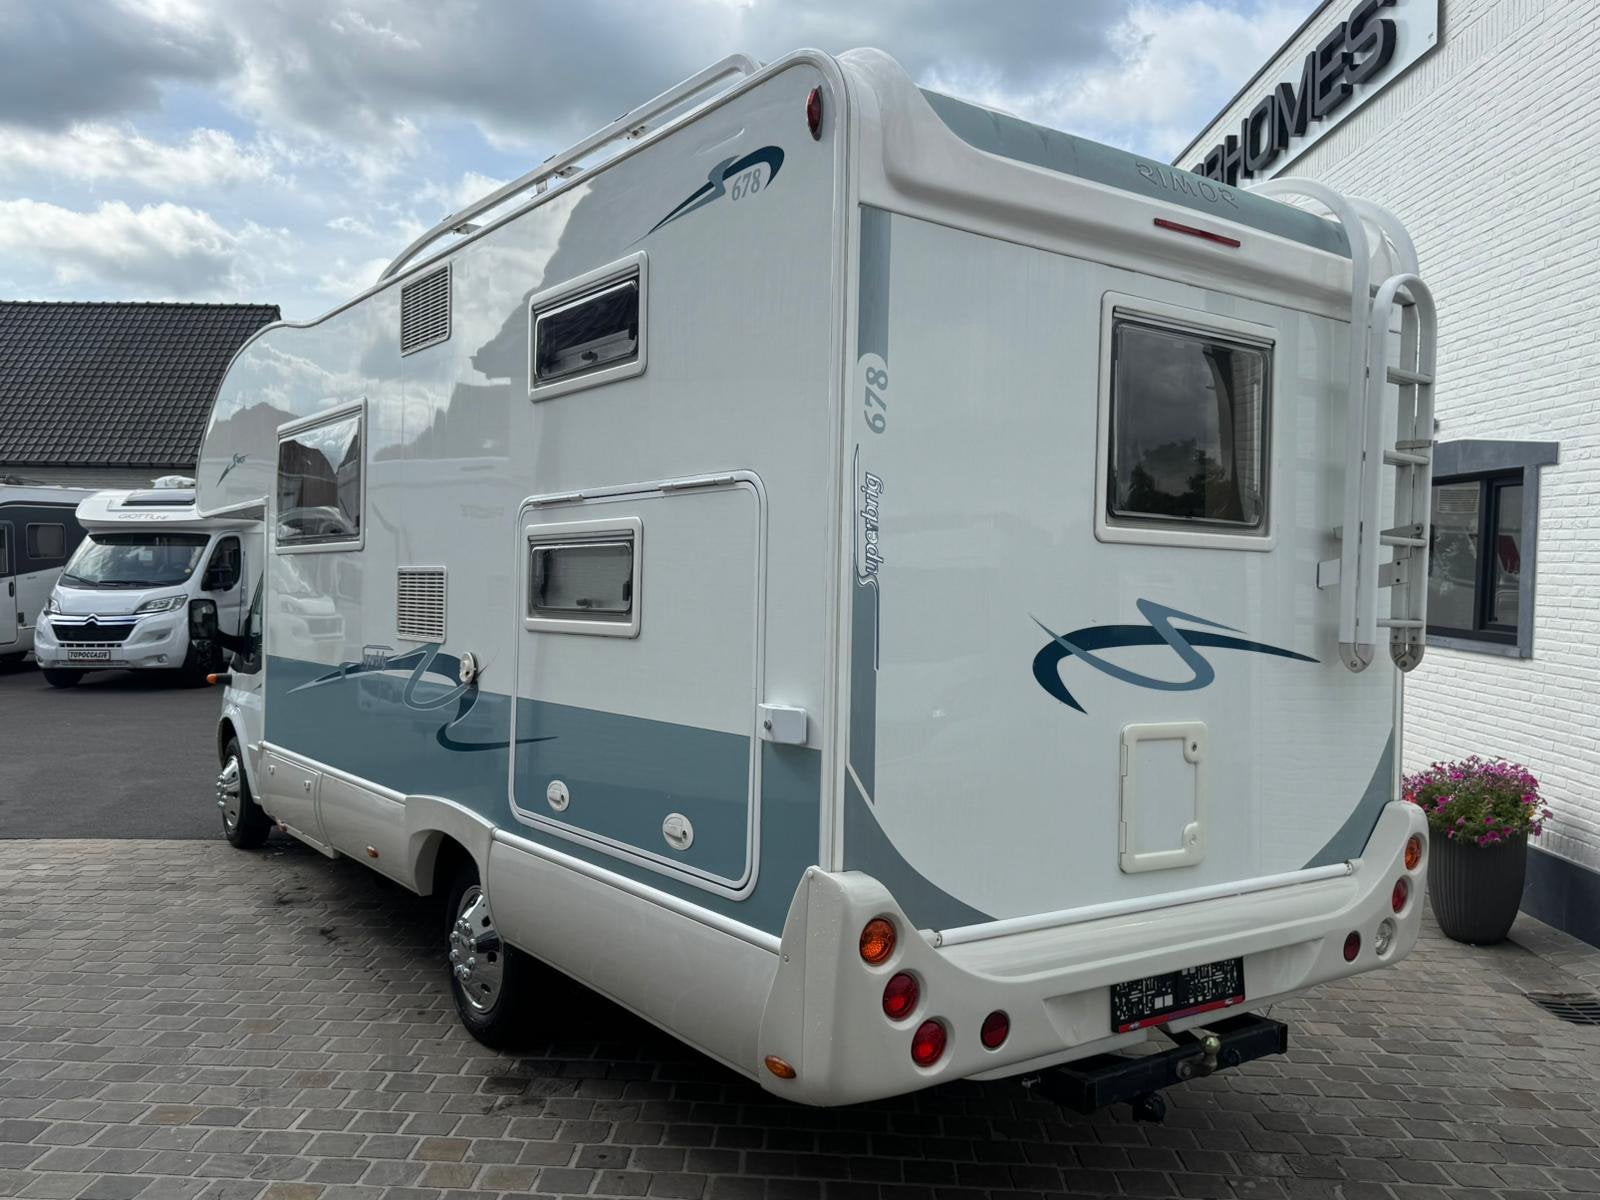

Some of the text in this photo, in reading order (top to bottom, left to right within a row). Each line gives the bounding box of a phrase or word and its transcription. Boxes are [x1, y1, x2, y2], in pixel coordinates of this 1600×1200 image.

[1190, 0, 1397, 188] RHOMES
[731, 168, 762, 201] 678
[863, 366, 889, 434] 678
[855, 471, 885, 588] Superbrig
